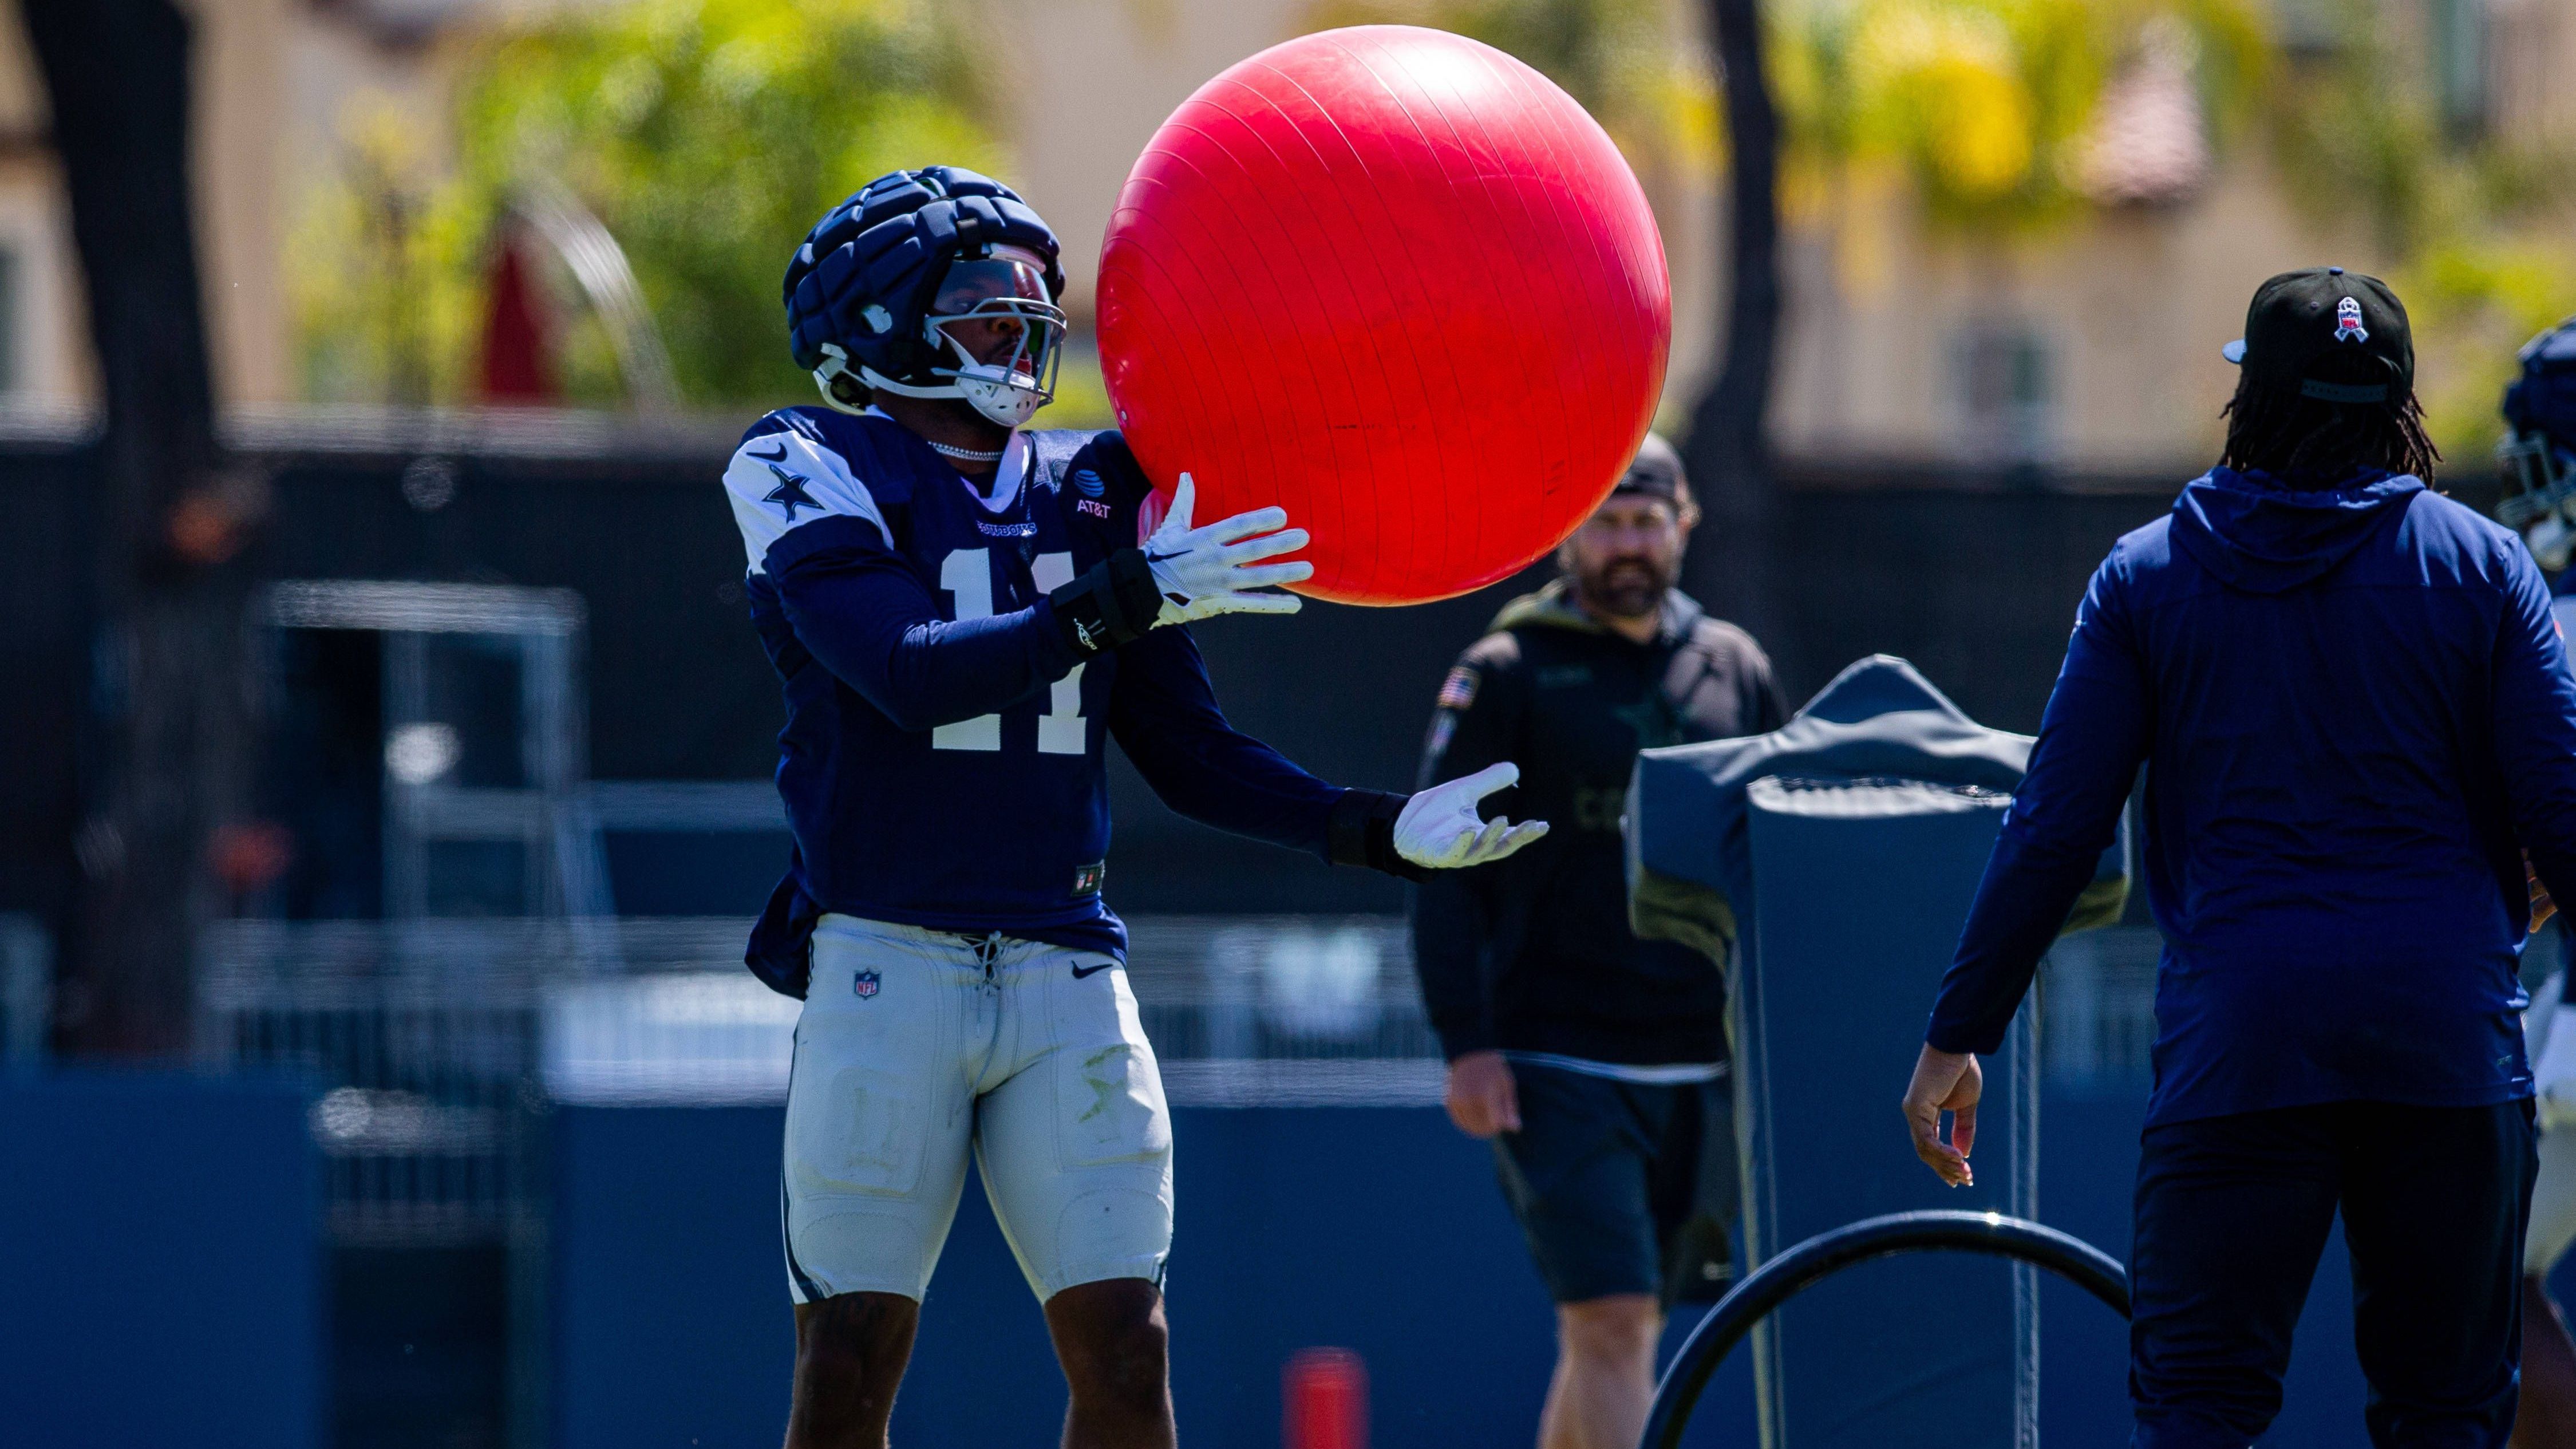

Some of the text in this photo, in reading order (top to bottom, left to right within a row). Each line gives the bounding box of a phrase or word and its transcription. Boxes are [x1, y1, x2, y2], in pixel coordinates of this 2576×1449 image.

[1077, 499, 1111, 519] AT&T
[933, 548, 1086, 755] 11
[856, 982, 877, 995] NFL
